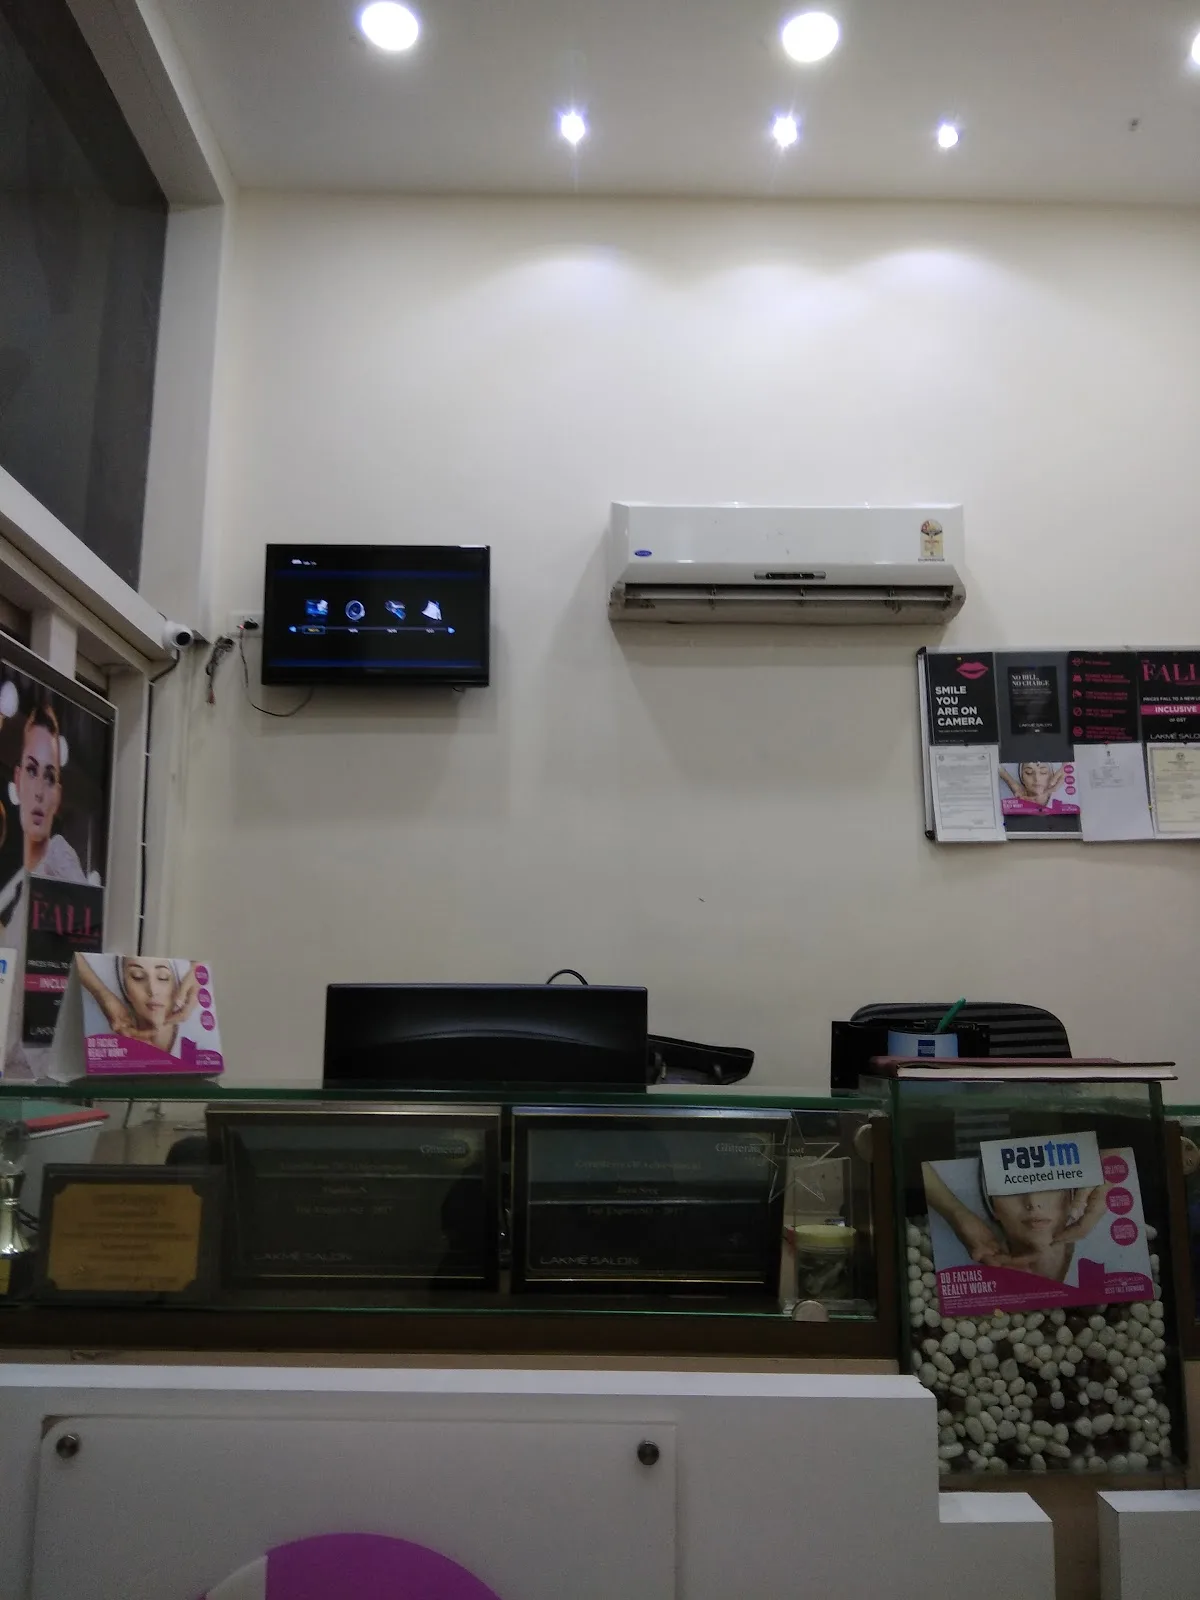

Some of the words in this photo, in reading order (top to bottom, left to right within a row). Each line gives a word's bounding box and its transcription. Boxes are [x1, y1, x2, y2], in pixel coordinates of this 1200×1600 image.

[935, 686, 967, 695] SMILE
[936, 696, 959, 705] YOU
[937, 707, 959, 716] ARE
[961, 706, 978, 716] ON
[938, 717, 984, 727] CAMERA
[1178, 732, 1200, 740] SALO
[1001, 1140, 1080, 1171] paytm
[1004, 1170, 1054, 1185] Accepted
[1057, 1169, 1083, 1180] Here
[952, 1270, 983, 1283] FACIALS
[941, 1283, 968, 1296] REALLY
[969, 1280, 997, 1294] WORK?
